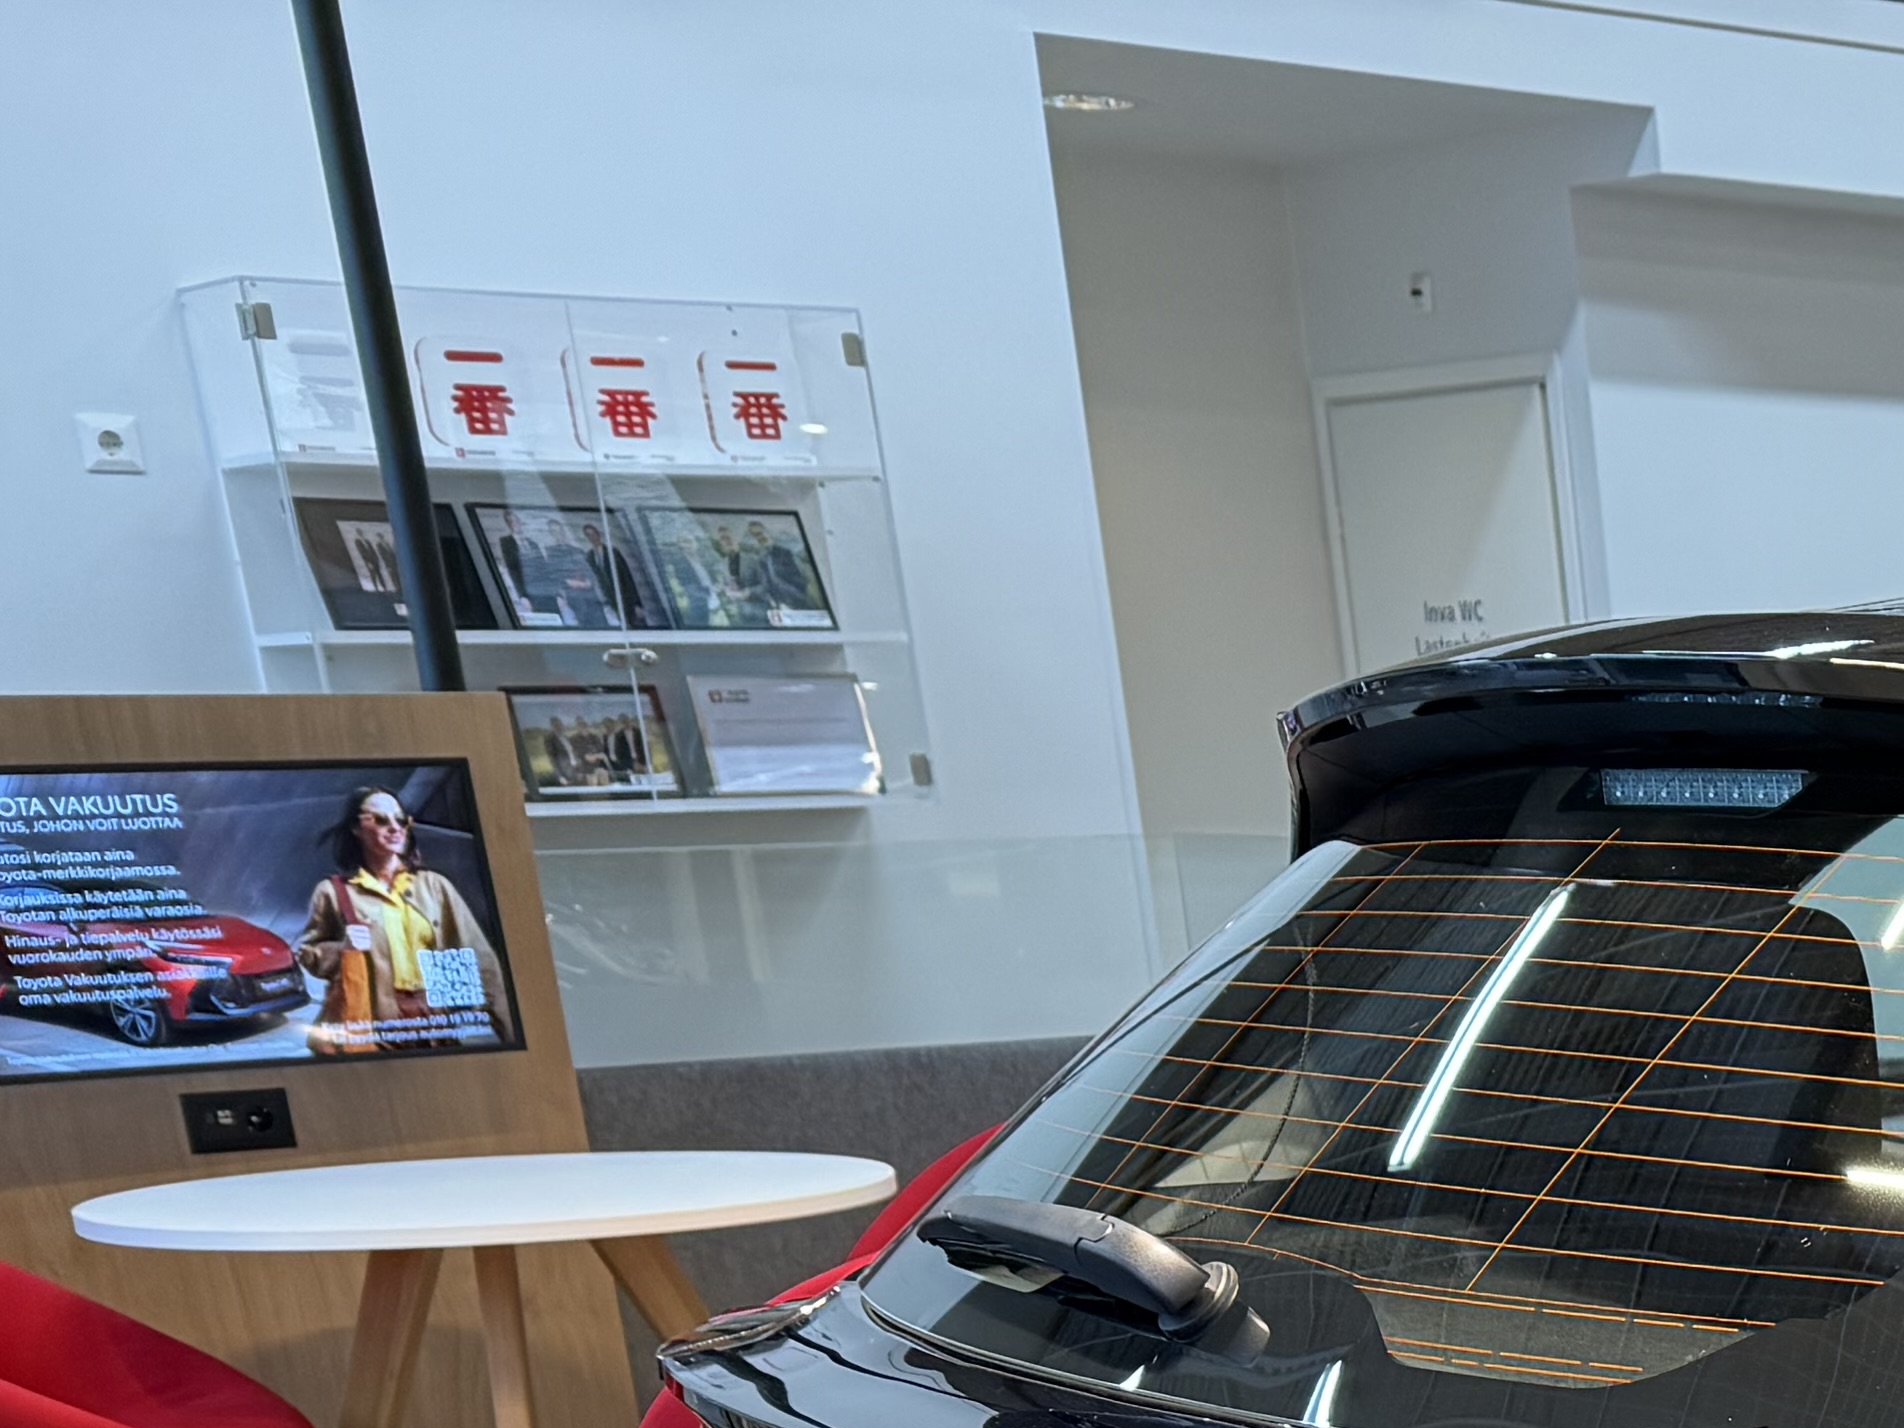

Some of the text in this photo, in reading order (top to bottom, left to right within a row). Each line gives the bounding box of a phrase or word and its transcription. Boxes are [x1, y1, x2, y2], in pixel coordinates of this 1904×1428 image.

[1423, 599, 1484, 622] Inva WC
[49, 793, 180, 816] VAKUUTUS
[33, 818, 84, 833] JOHON
[86, 818, 119, 831] VOIT
[121, 816, 183, 830] LUOTTAA
[33, 849, 101, 866] korjataan
[103, 848, 136, 863] aina
[84, 888, 154, 906] käytetään
[157, 886, 188, 900] aina
[59, 905, 145, 922] alkuperäisiä
[146, 903, 208, 918] varaosia.
[4, 926, 224, 949] Hinaus- ja tiepalvelu käytössäsi
[8, 948, 104, 965] vuorokauden
[13, 975, 63, 991] Toyota
[64, 970, 154, 987] Vakuutuksen
[19, 986, 171, 1007] oma vakuutuspalvelu.
